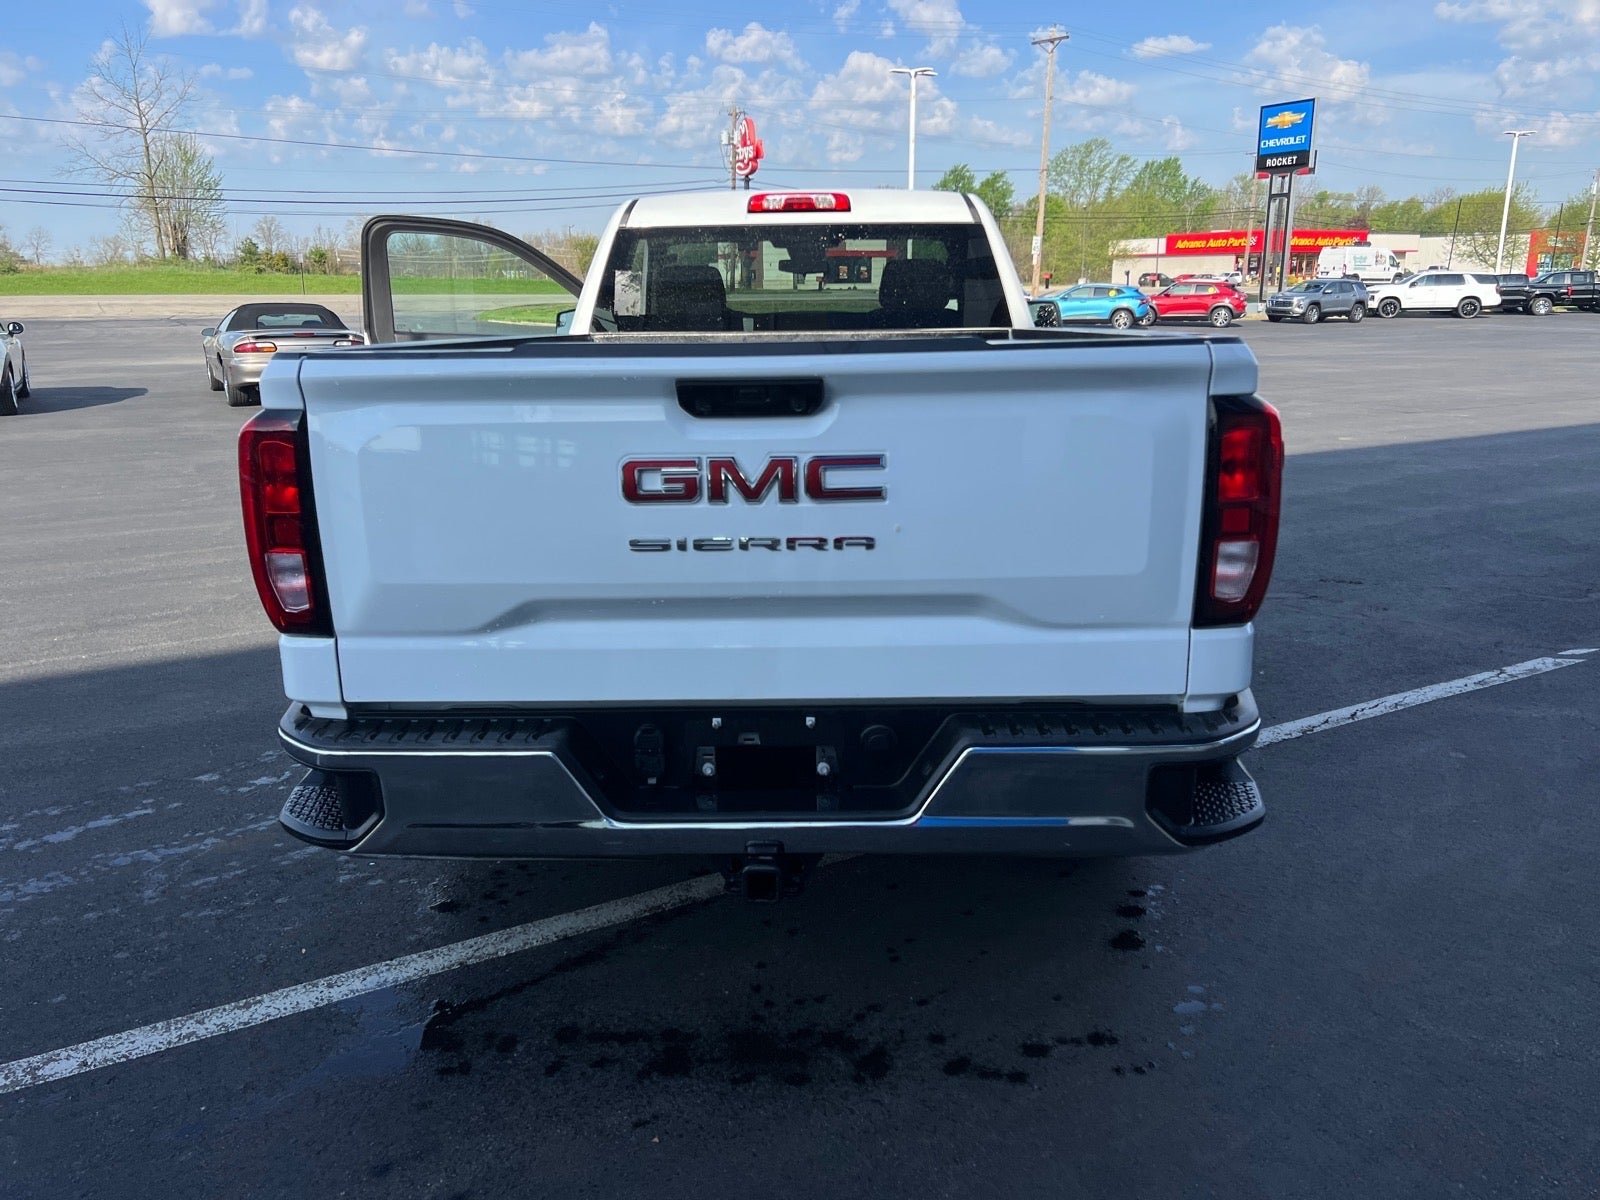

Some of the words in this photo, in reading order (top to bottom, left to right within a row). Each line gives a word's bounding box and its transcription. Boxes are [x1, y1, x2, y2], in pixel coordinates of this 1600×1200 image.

[1261, 135, 1307, 148] CHEVROLET
[1266, 156, 1298, 167] ROCKET
[1175, 239, 1207, 249] Advance
[1206, 238, 1228, 248] Auto
[1290, 236, 1316, 246] dvance
[1315, 236, 1334, 246] Auto
[621, 453, 887, 504] GMC
[628, 536, 876, 551] SIERRA
